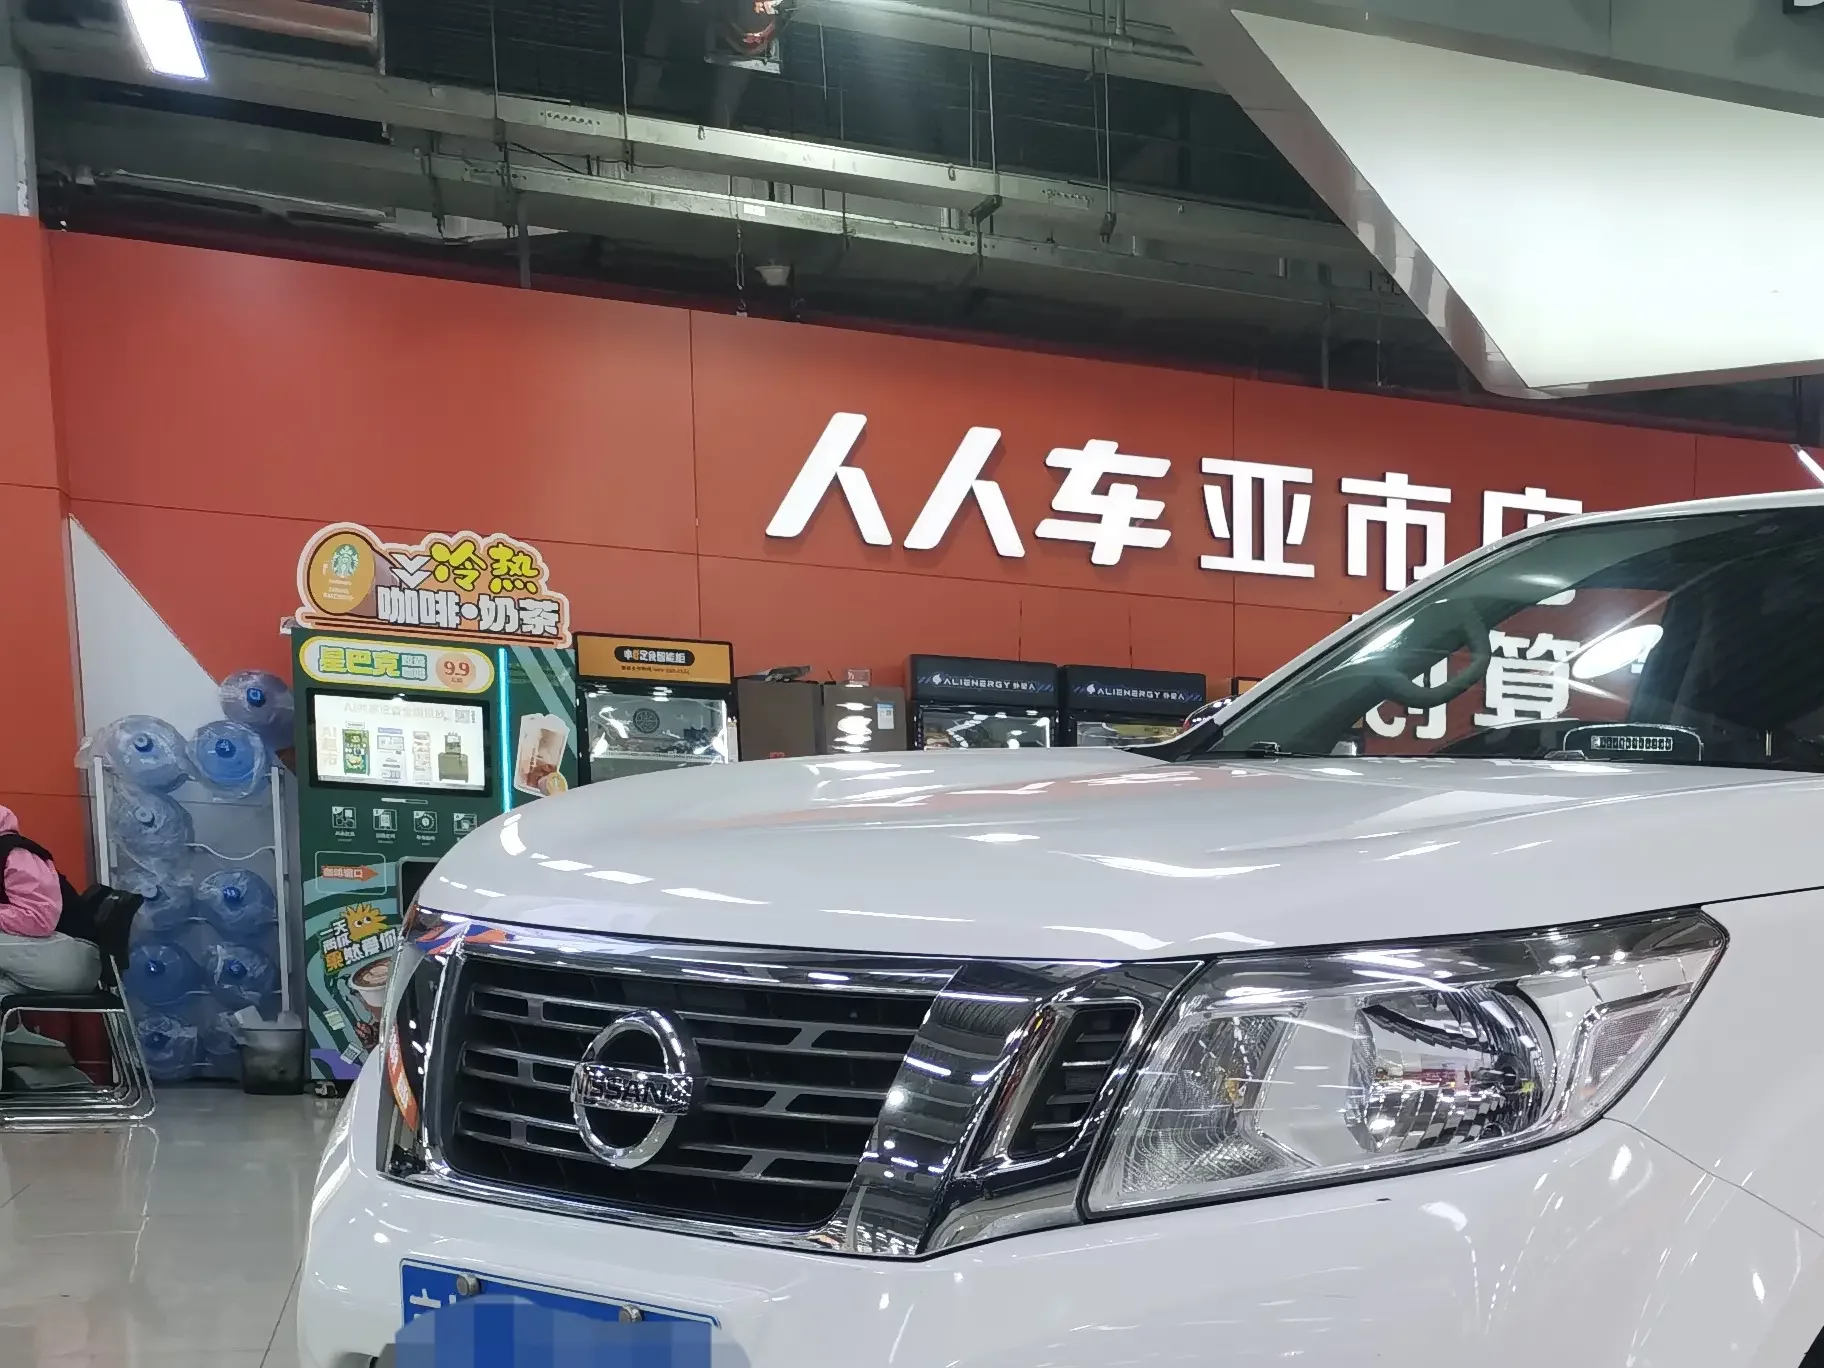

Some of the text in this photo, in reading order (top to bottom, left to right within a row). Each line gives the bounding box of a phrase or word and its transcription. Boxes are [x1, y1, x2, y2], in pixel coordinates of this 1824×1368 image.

[430, 539, 539, 594] 冷热
[319, 645, 401, 679] 星巴克
[443, 660, 470, 677] 9.9
[943, 677, 1010, 689] ALIENERGY
[1097, 688, 1161, 699] ALIENERGY
[572, 1068, 670, 1107] NISSAN
